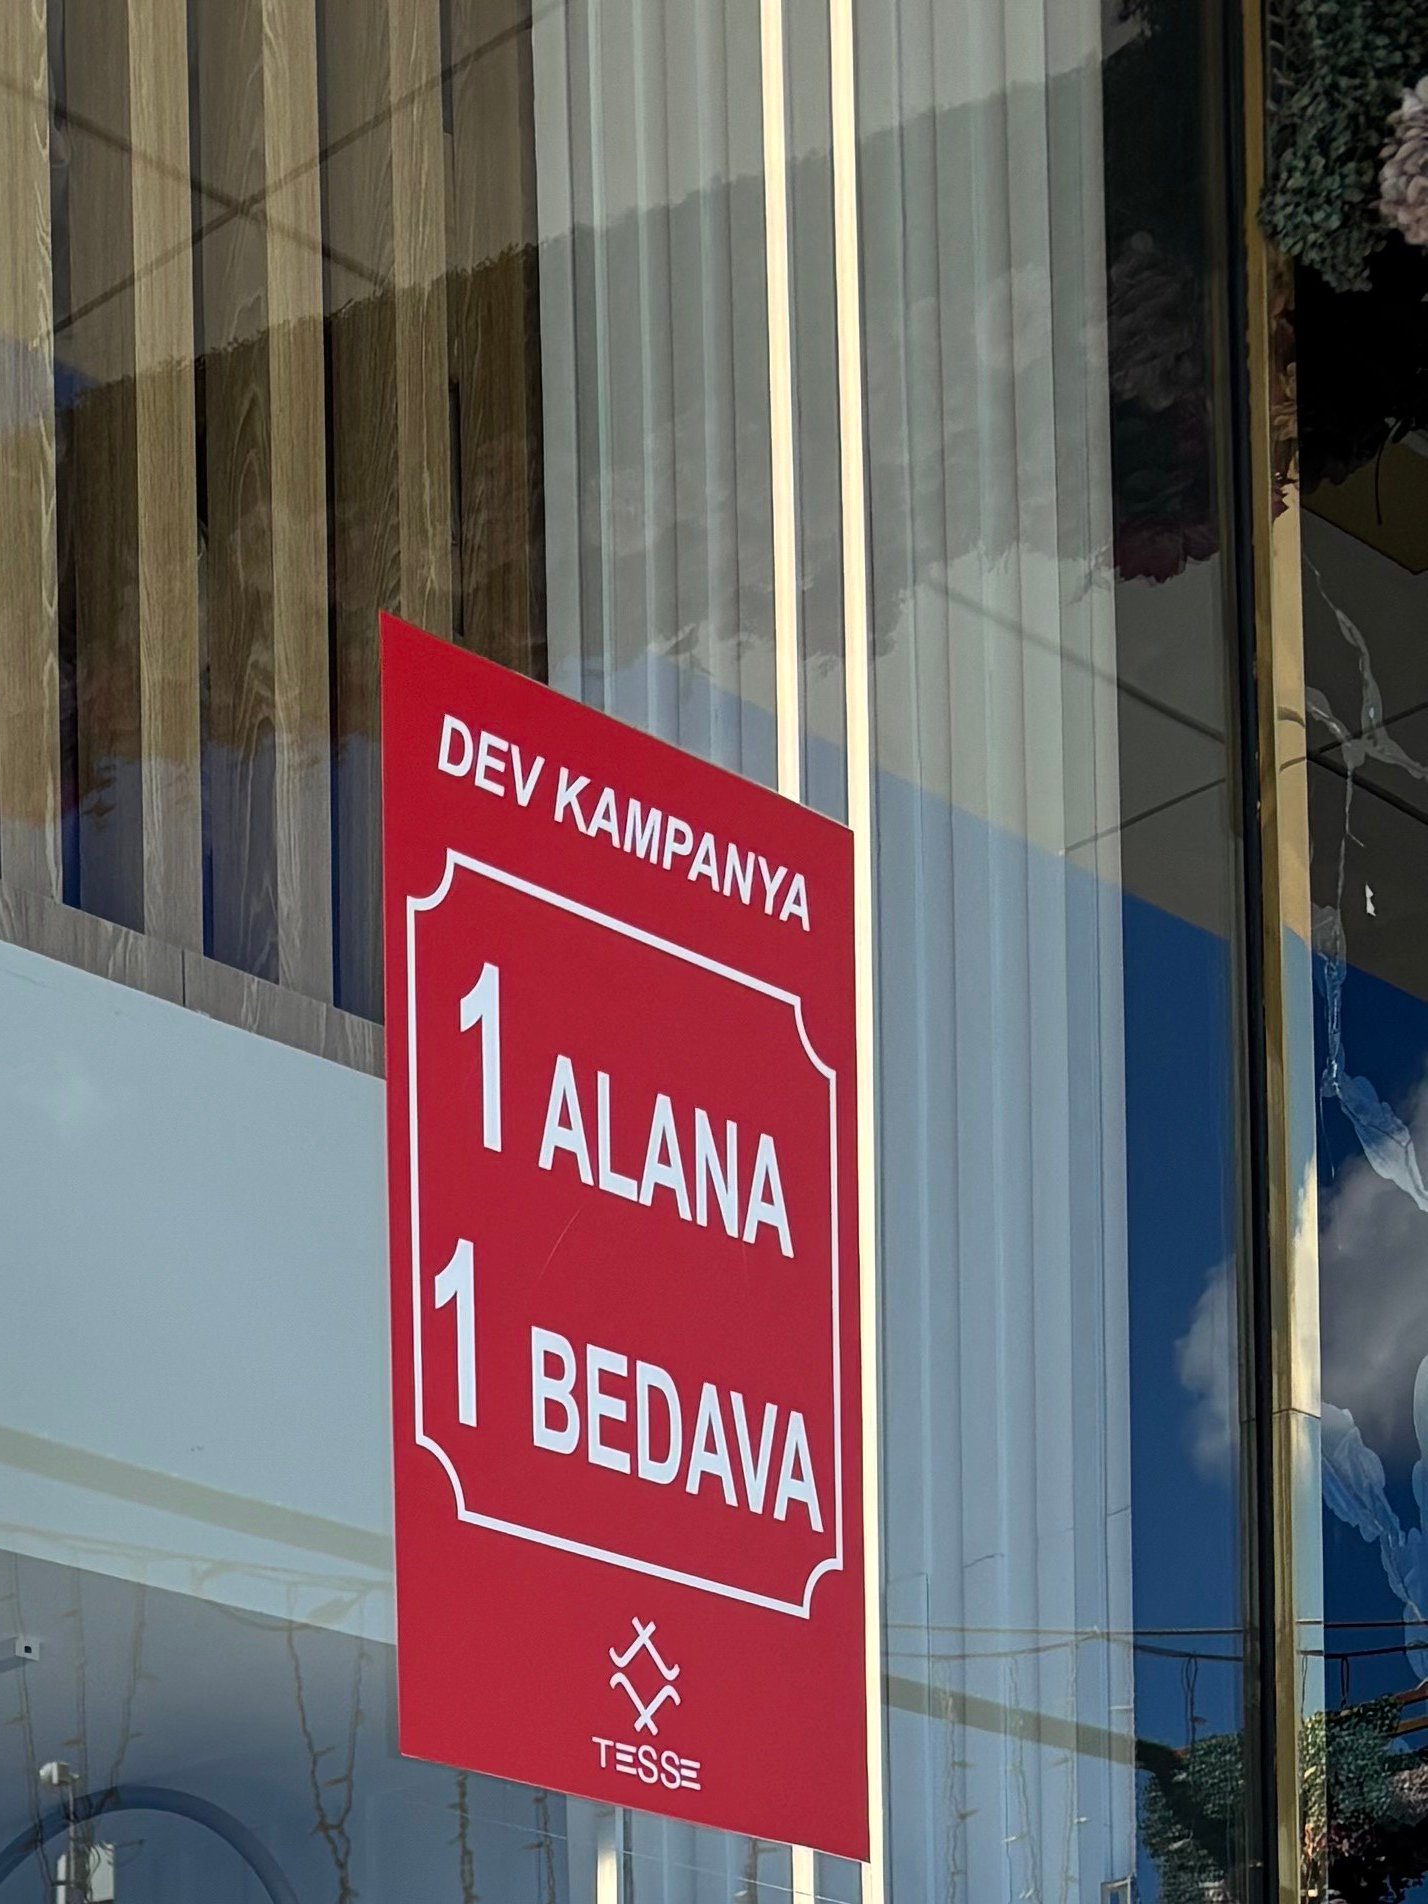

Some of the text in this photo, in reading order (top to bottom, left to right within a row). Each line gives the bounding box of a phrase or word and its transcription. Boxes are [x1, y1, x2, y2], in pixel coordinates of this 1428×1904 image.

[437, 713, 811, 932] DEV KAMPANYA
[460, 961, 794, 1259] 1 ALANA
[434, 1237, 824, 1533] 1 BEDAVA
[591, 1735, 701, 1791] TESSE
